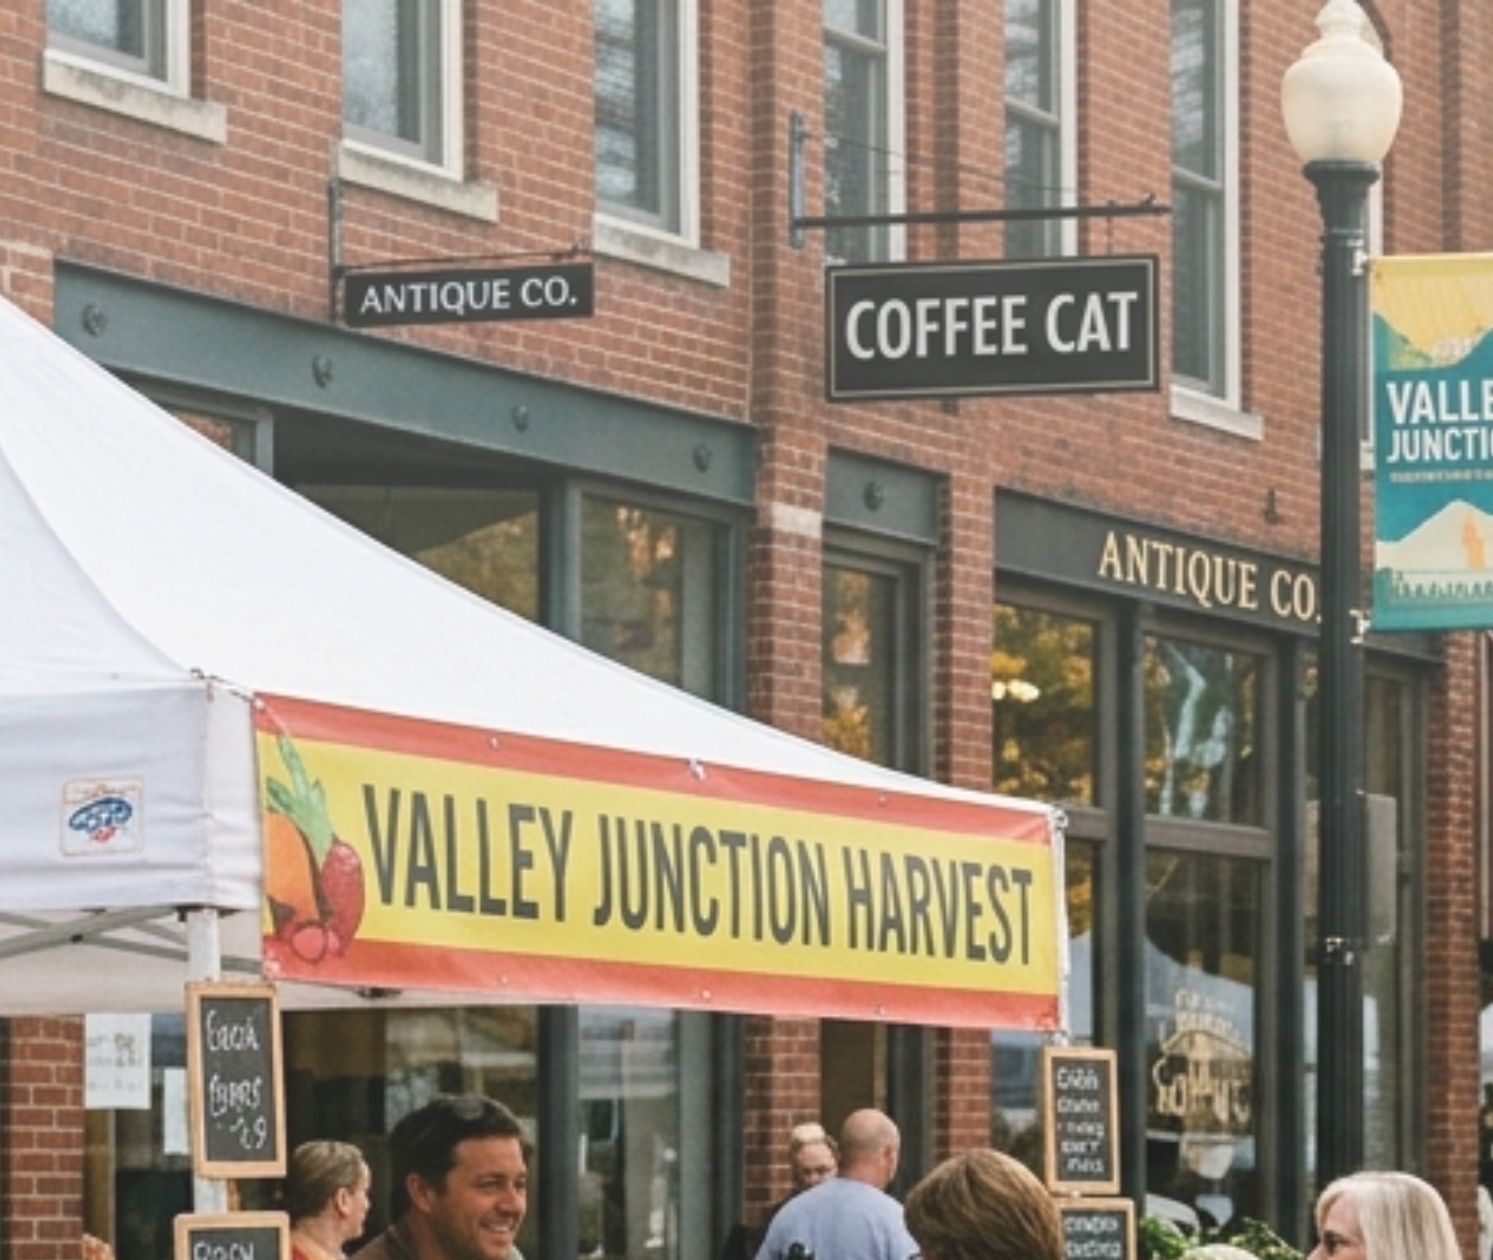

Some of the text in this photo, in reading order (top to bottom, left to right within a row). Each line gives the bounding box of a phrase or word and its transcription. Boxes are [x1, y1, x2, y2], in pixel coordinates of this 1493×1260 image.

[360, 277, 577, 315] ANTIQUE CO.
[844, 291, 1139, 359] COFFEE CAT
[1098, 531, 1322, 624] ANTIQUE CO.
[362, 784, 1034, 965] VALLEY JUNCTION HARVEST
